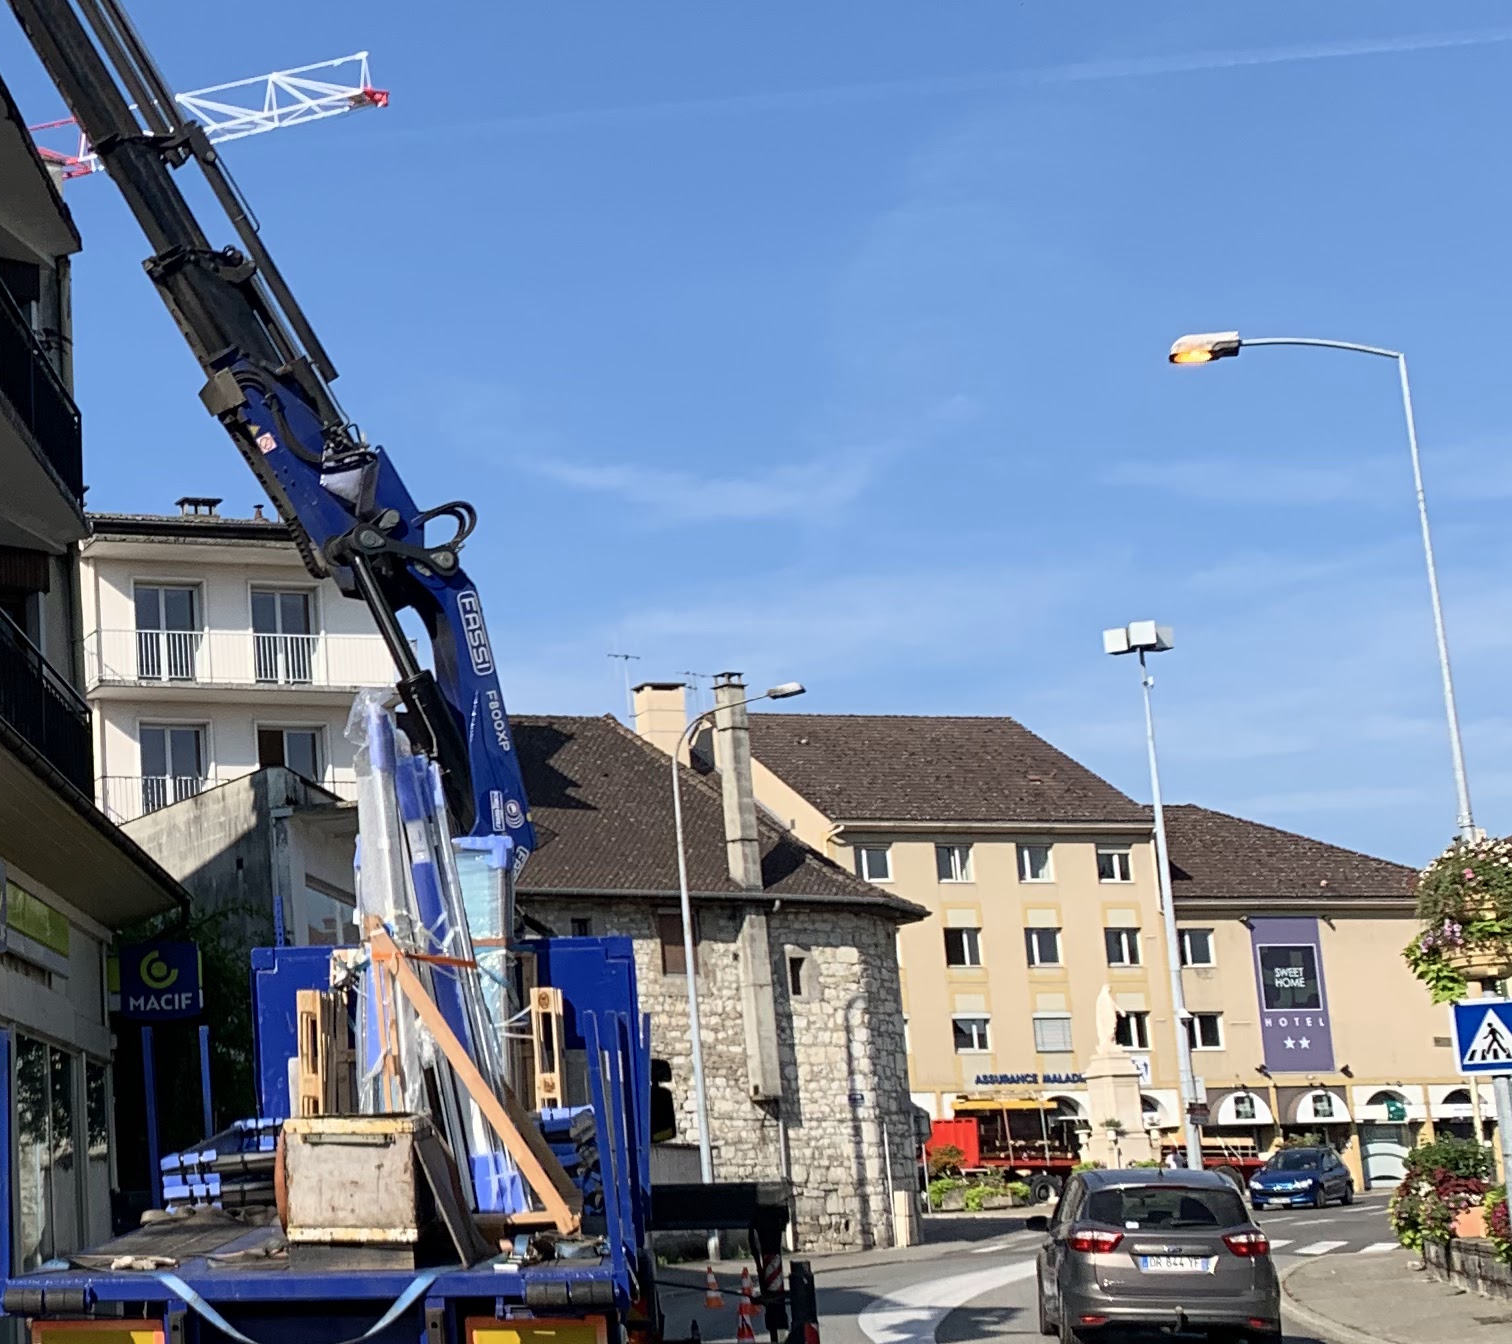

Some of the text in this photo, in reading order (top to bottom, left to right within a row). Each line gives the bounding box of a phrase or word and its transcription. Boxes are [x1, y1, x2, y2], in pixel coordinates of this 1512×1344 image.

[461, 596, 490, 672] FASSI
[486, 689, 511, 752] F800XP
[1274, 967, 1305, 978] SWEET
[1275, 977, 1306, 988] HOME
[129, 992, 193, 1012] MACIF
[1264, 1017, 1325, 1027] HOTEL
